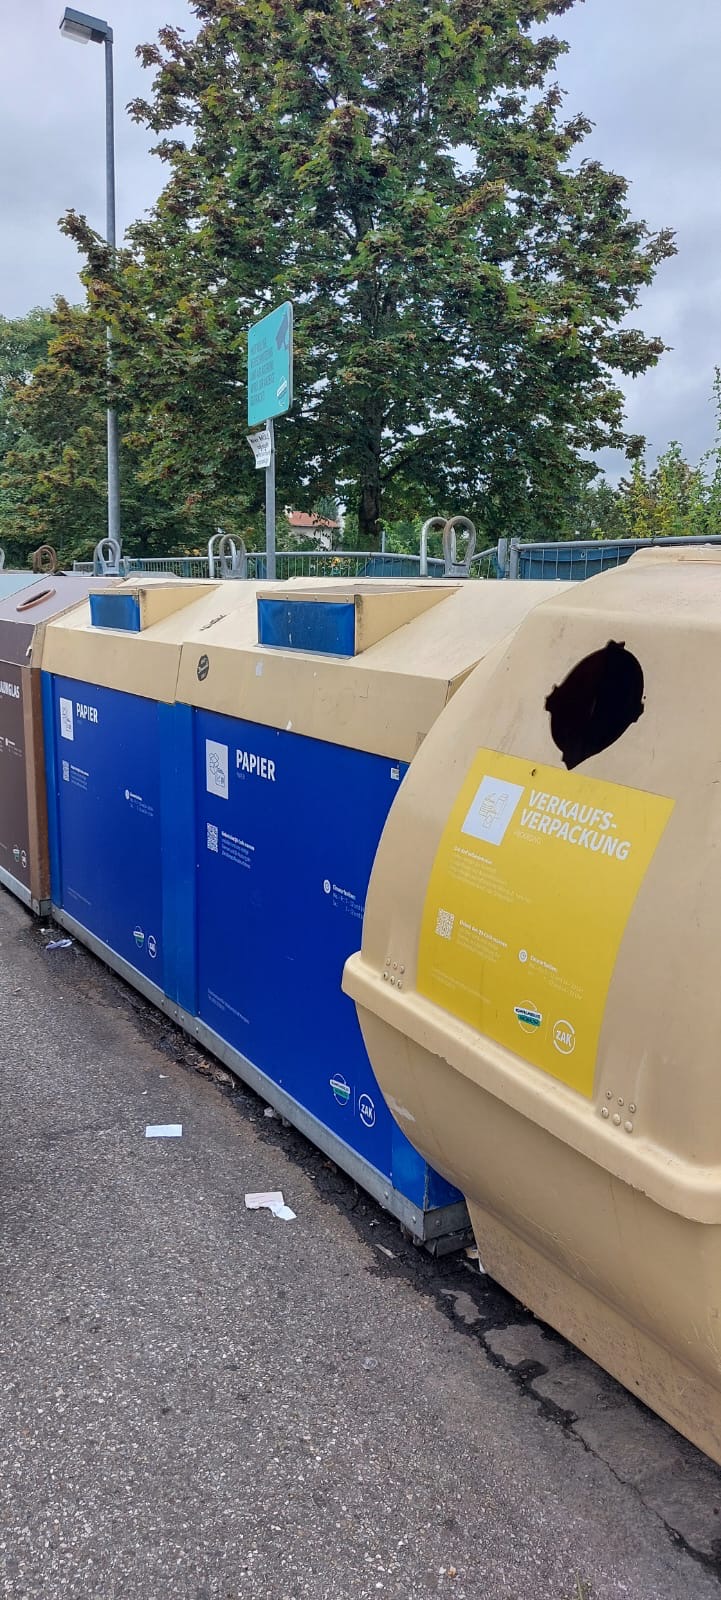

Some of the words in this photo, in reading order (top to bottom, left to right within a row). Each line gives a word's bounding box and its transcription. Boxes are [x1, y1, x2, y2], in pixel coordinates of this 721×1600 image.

[76, 702, 98, 724] PAPIER
[236, 749, 276, 782] PAPIER
[529, 789, 617, 831] VERKAUFS-
[519, 808, 632, 861] VERPACKUNG
[556, 1030, 572, 1048] ZAK
[361, 1103, 373, 1121] ZAK
